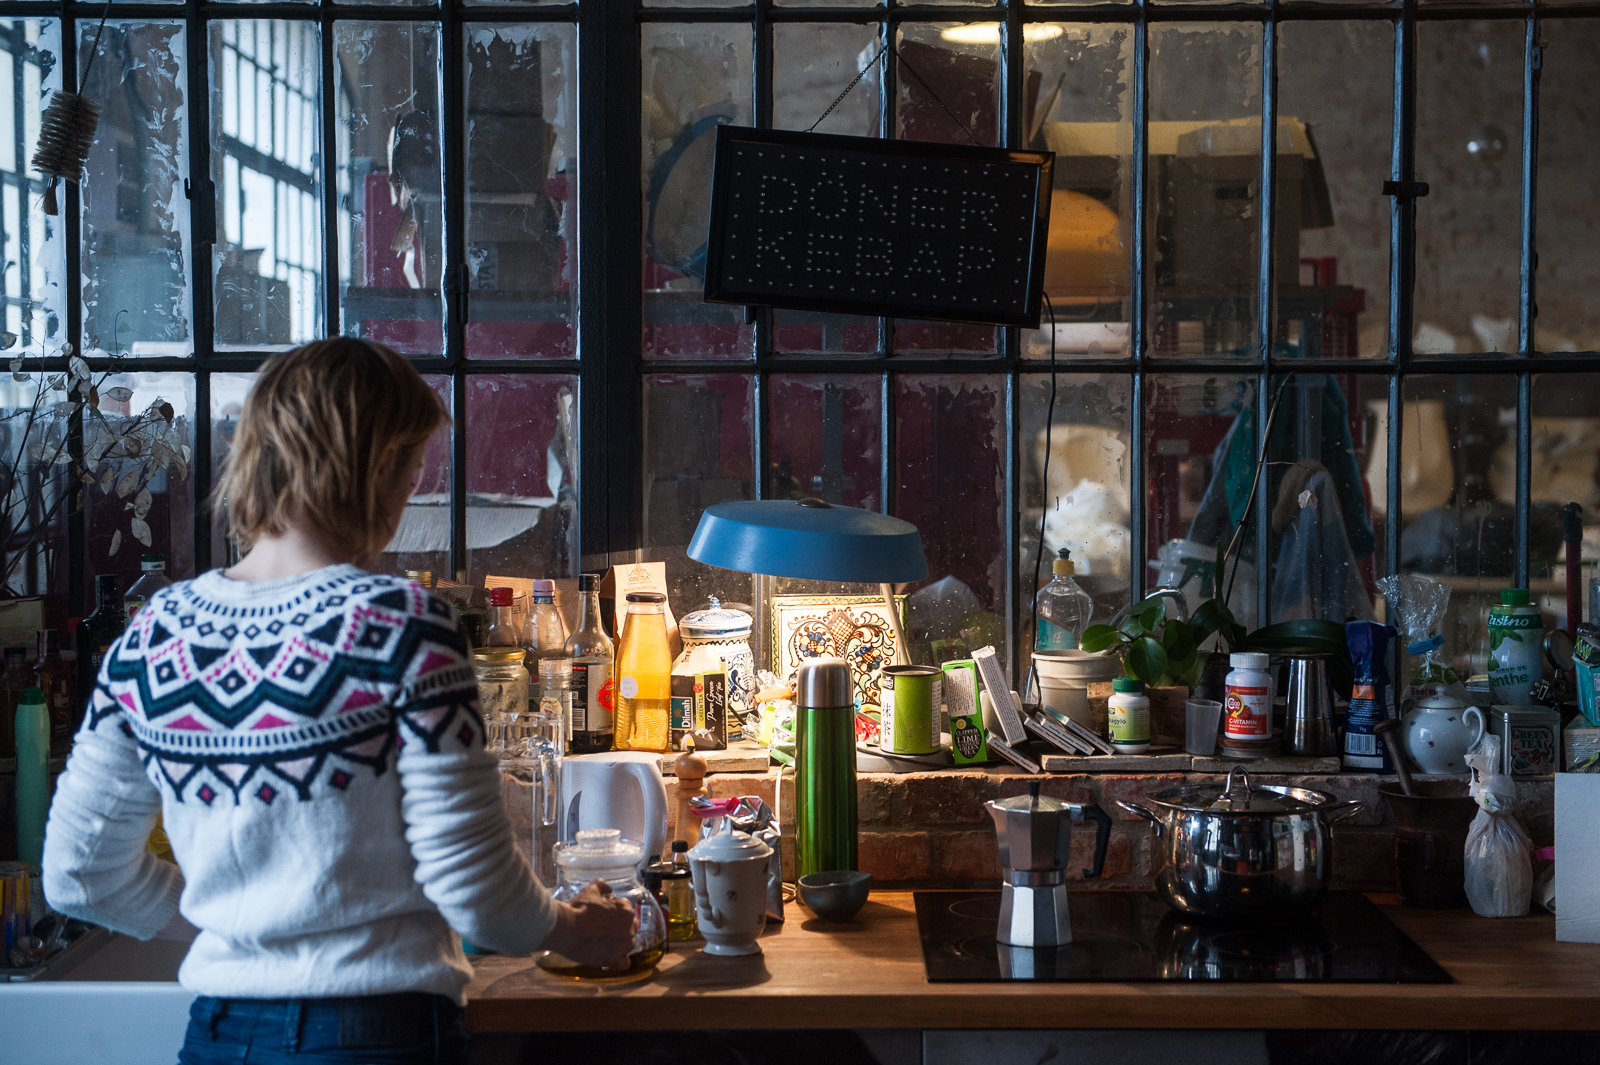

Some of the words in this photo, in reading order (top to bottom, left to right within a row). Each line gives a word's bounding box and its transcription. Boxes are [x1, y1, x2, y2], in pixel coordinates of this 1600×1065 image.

[756, 228, 997, 284] KEBAP
[1488, 614, 1530, 627] Casino
[1489, 673, 1529, 687] enthe
[706, 681, 718, 702] Green
[681, 699, 691, 728] Dilmah
[706, 703, 717, 722] Pure
[955, 728, 979, 736] CLIPPER
[956, 734, 980, 743] LIME
[1511, 729, 1549, 739] GREEN
[1520, 740, 1543, 749] TEA
